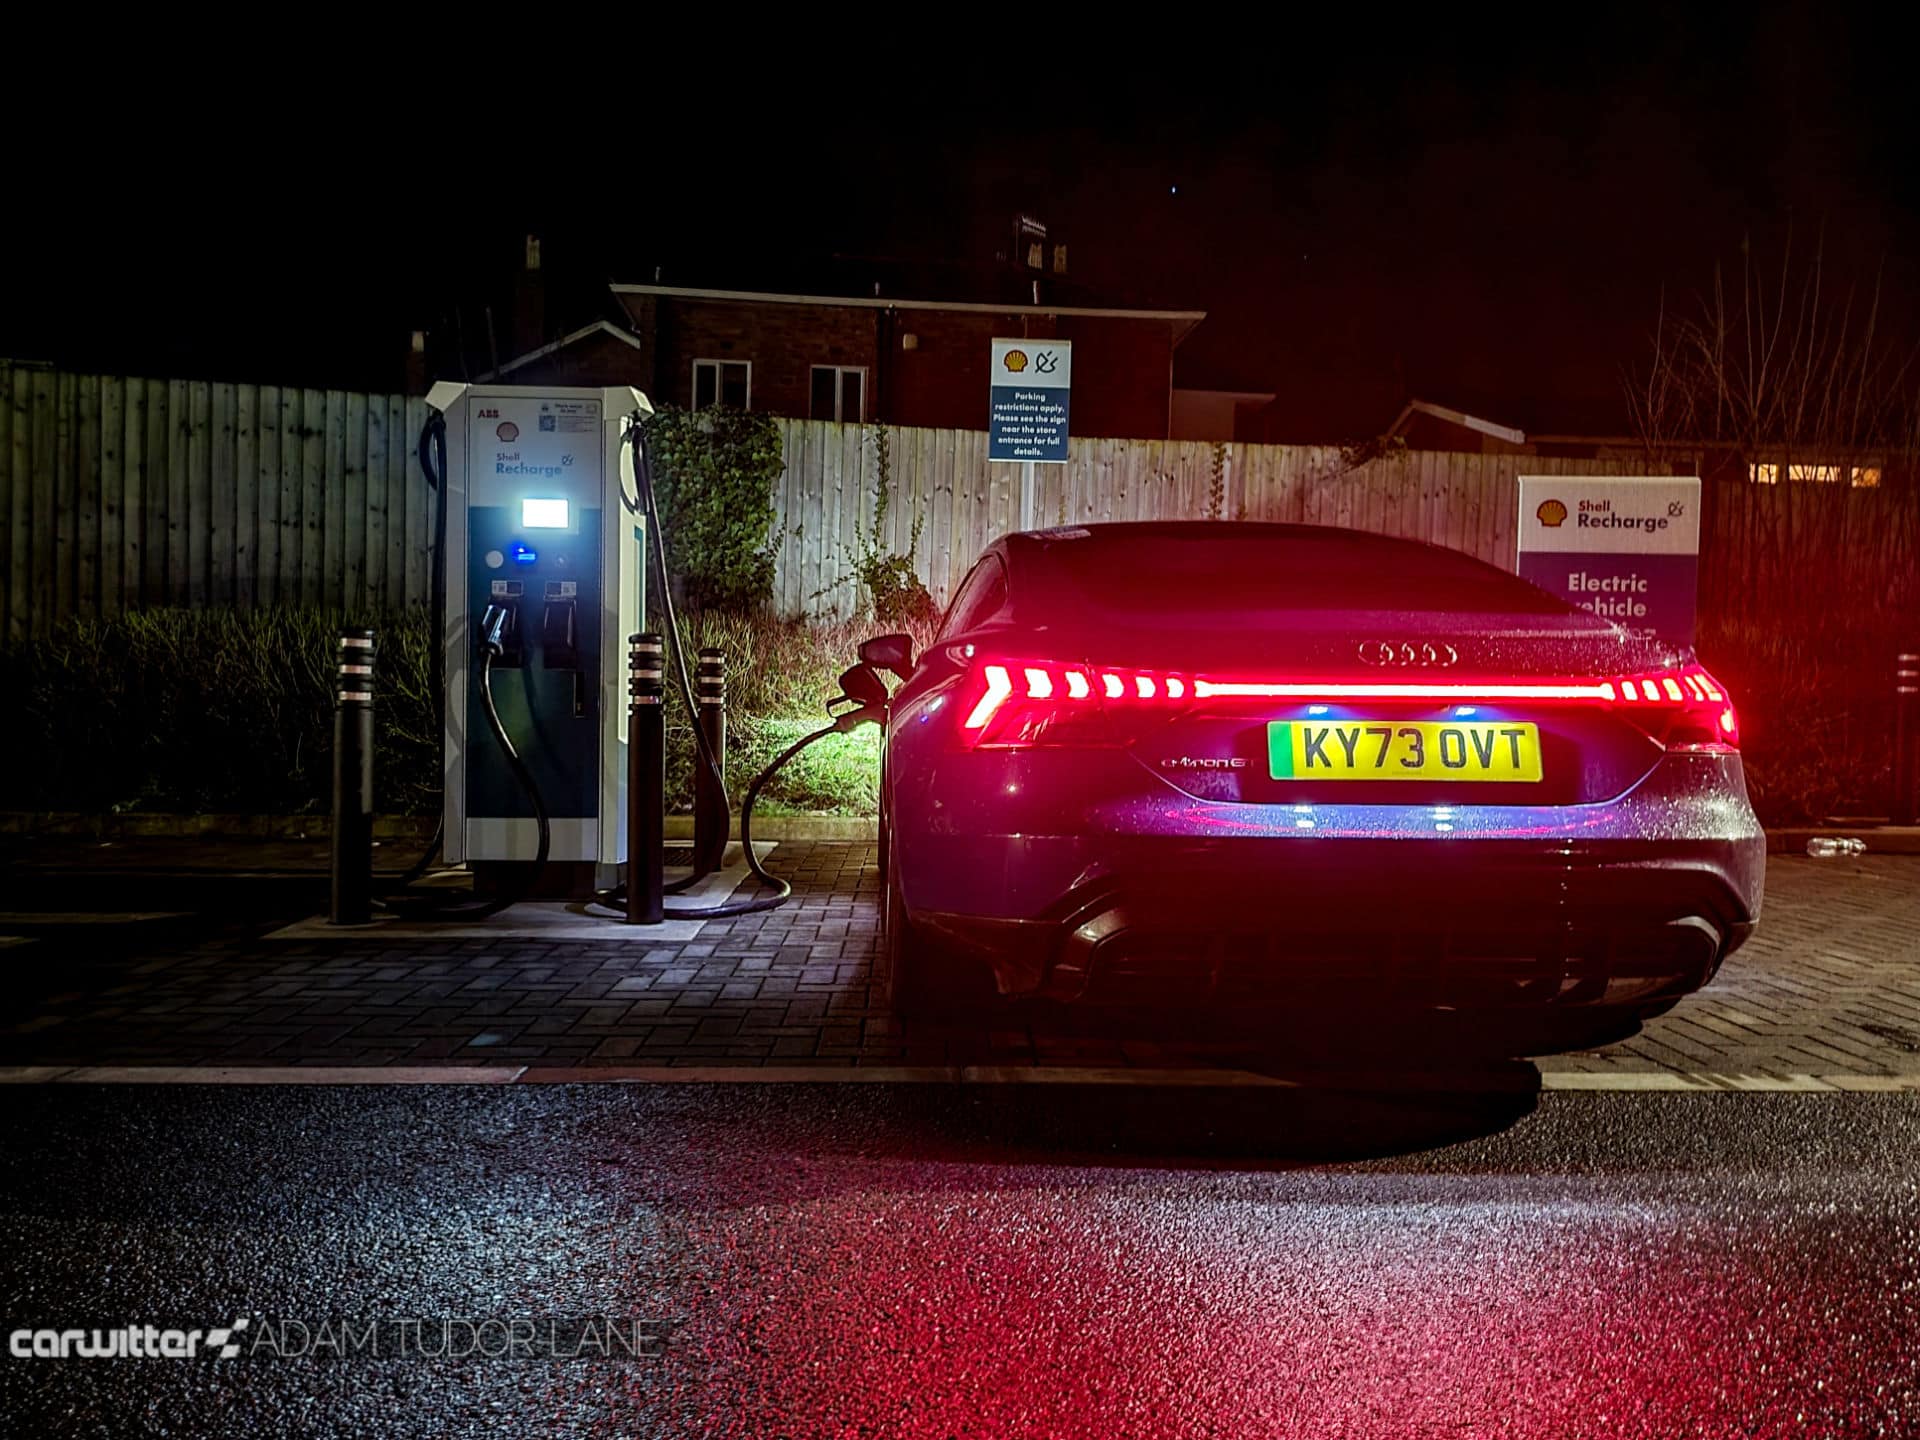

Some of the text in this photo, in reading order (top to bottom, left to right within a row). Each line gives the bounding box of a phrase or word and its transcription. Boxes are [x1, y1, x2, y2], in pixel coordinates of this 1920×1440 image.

[1015, 392, 1046, 402] Parking
[478, 409, 500, 418] ABB
[995, 403, 1065, 414] restrictions apply.
[993, 413, 1019, 421] Please
[1035, 415, 1048, 423] the
[1049, 416, 1066, 425] sign
[1021, 425, 1035, 433] the
[1034, 437, 1046, 445] for
[1047, 437, 1060, 445] full
[496, 453, 520, 461] Shell
[1014, 447, 1043, 456] details.
[496, 462, 563, 477] Recharge
[1577, 501, 1610, 513] Shell
[1577, 512, 1668, 533] Recharge
[1568, 572, 1648, 593] Electric
[1575, 597, 1647, 617] ehicle
[1303, 728, 1526, 769] KY73 OVT
